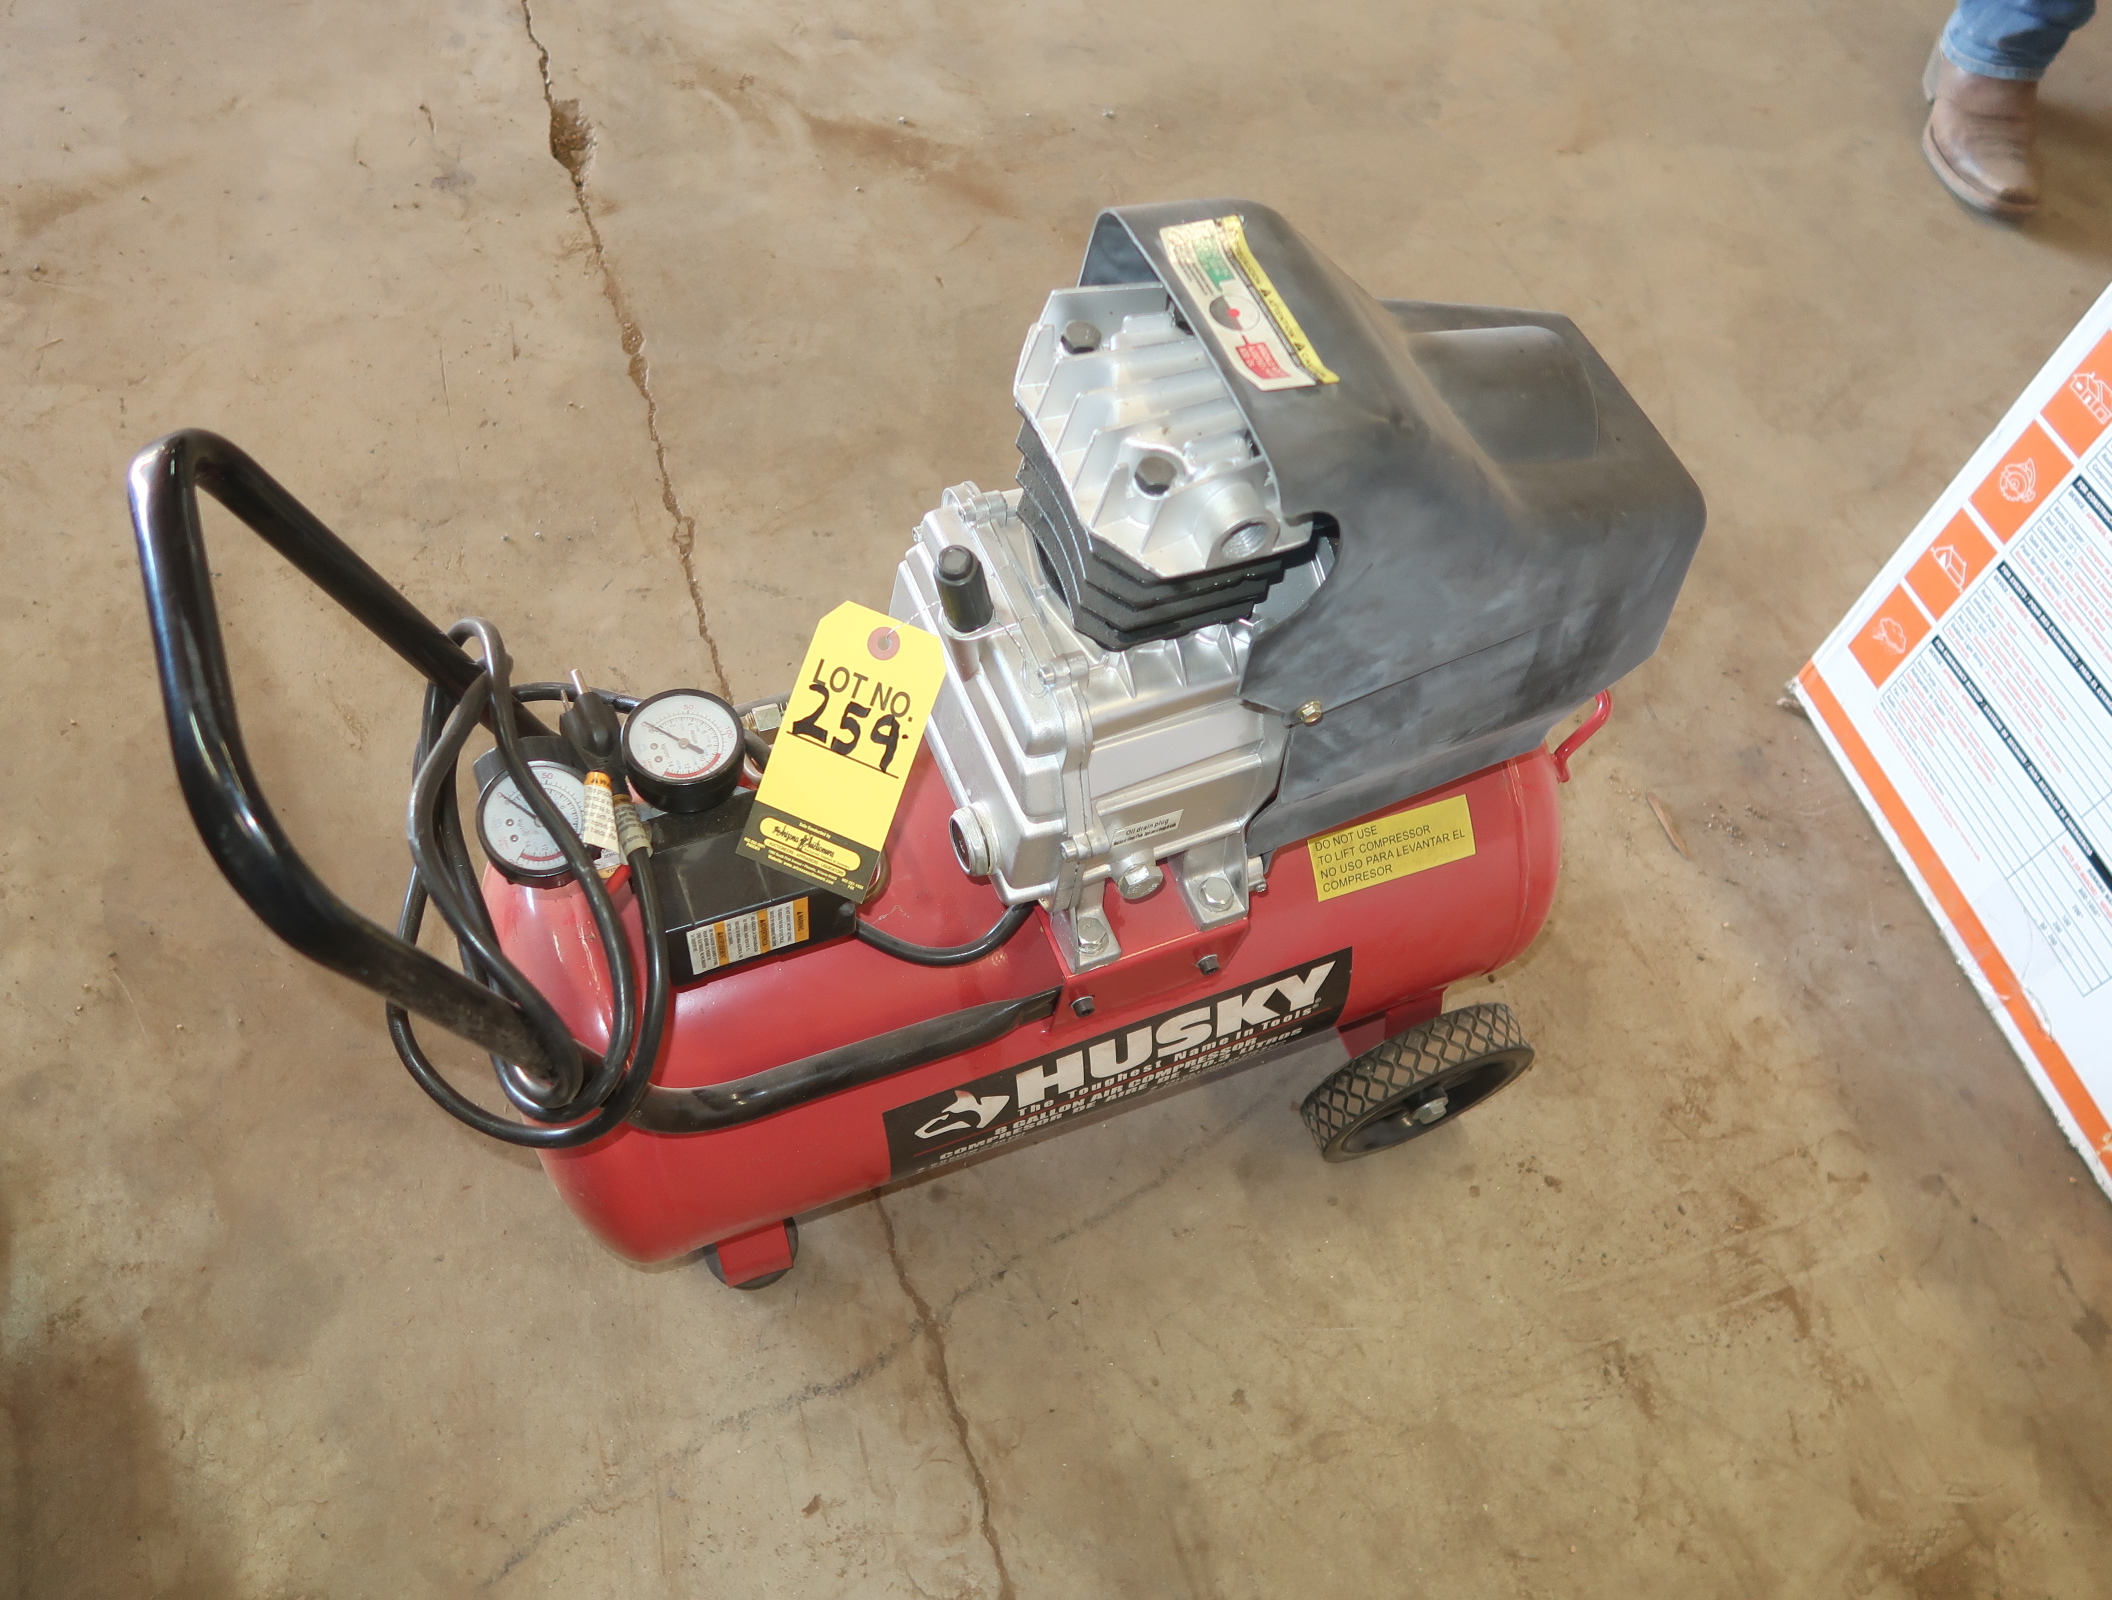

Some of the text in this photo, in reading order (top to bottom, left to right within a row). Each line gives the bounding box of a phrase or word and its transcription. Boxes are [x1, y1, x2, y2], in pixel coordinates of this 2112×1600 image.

[813, 658, 912, 721] LOT NO.
[792, 683, 901, 773] 259
[1136, 823, 1153, 832] drain
[1154, 819, 1169, 828] plug
[1315, 826, 1378, 851] DO NOT USE
[1318, 825, 1431, 865] TO LIFT COMPRESSOR
[1320, 829, 1465, 879] NO USO PARA LEVANTAR EL
[1323, 864, 1393, 892] COMPRESOR
[1016, 960, 1336, 1108] HUSKY
[1018, 1098, 1054, 1117] The
[1068, 1059, 1163, 1099] Toughest
[1174, 1037, 1228, 1062] Name
[1235, 1026, 1254, 1040] In
[1261, 1006, 1312, 1030] Tools
[939, 1113, 1062, 1159] COMPRESOR
[1072, 1101, 1096, 1114] DE
[1103, 1083, 1148, 1103] AIRE
[1157, 1071, 1180, 1084] DE
[1190, 1053, 1230, 1071] 30.3
[1240, 1027, 1302, 1054] LITROS
[994, 1126, 1007, 1135] 8
[1012, 1098, 1086, 1128] GALLON
[1091, 1084, 1123, 1101] AIR
[1128, 1037, 1257, 1088] COMPRESSOR
